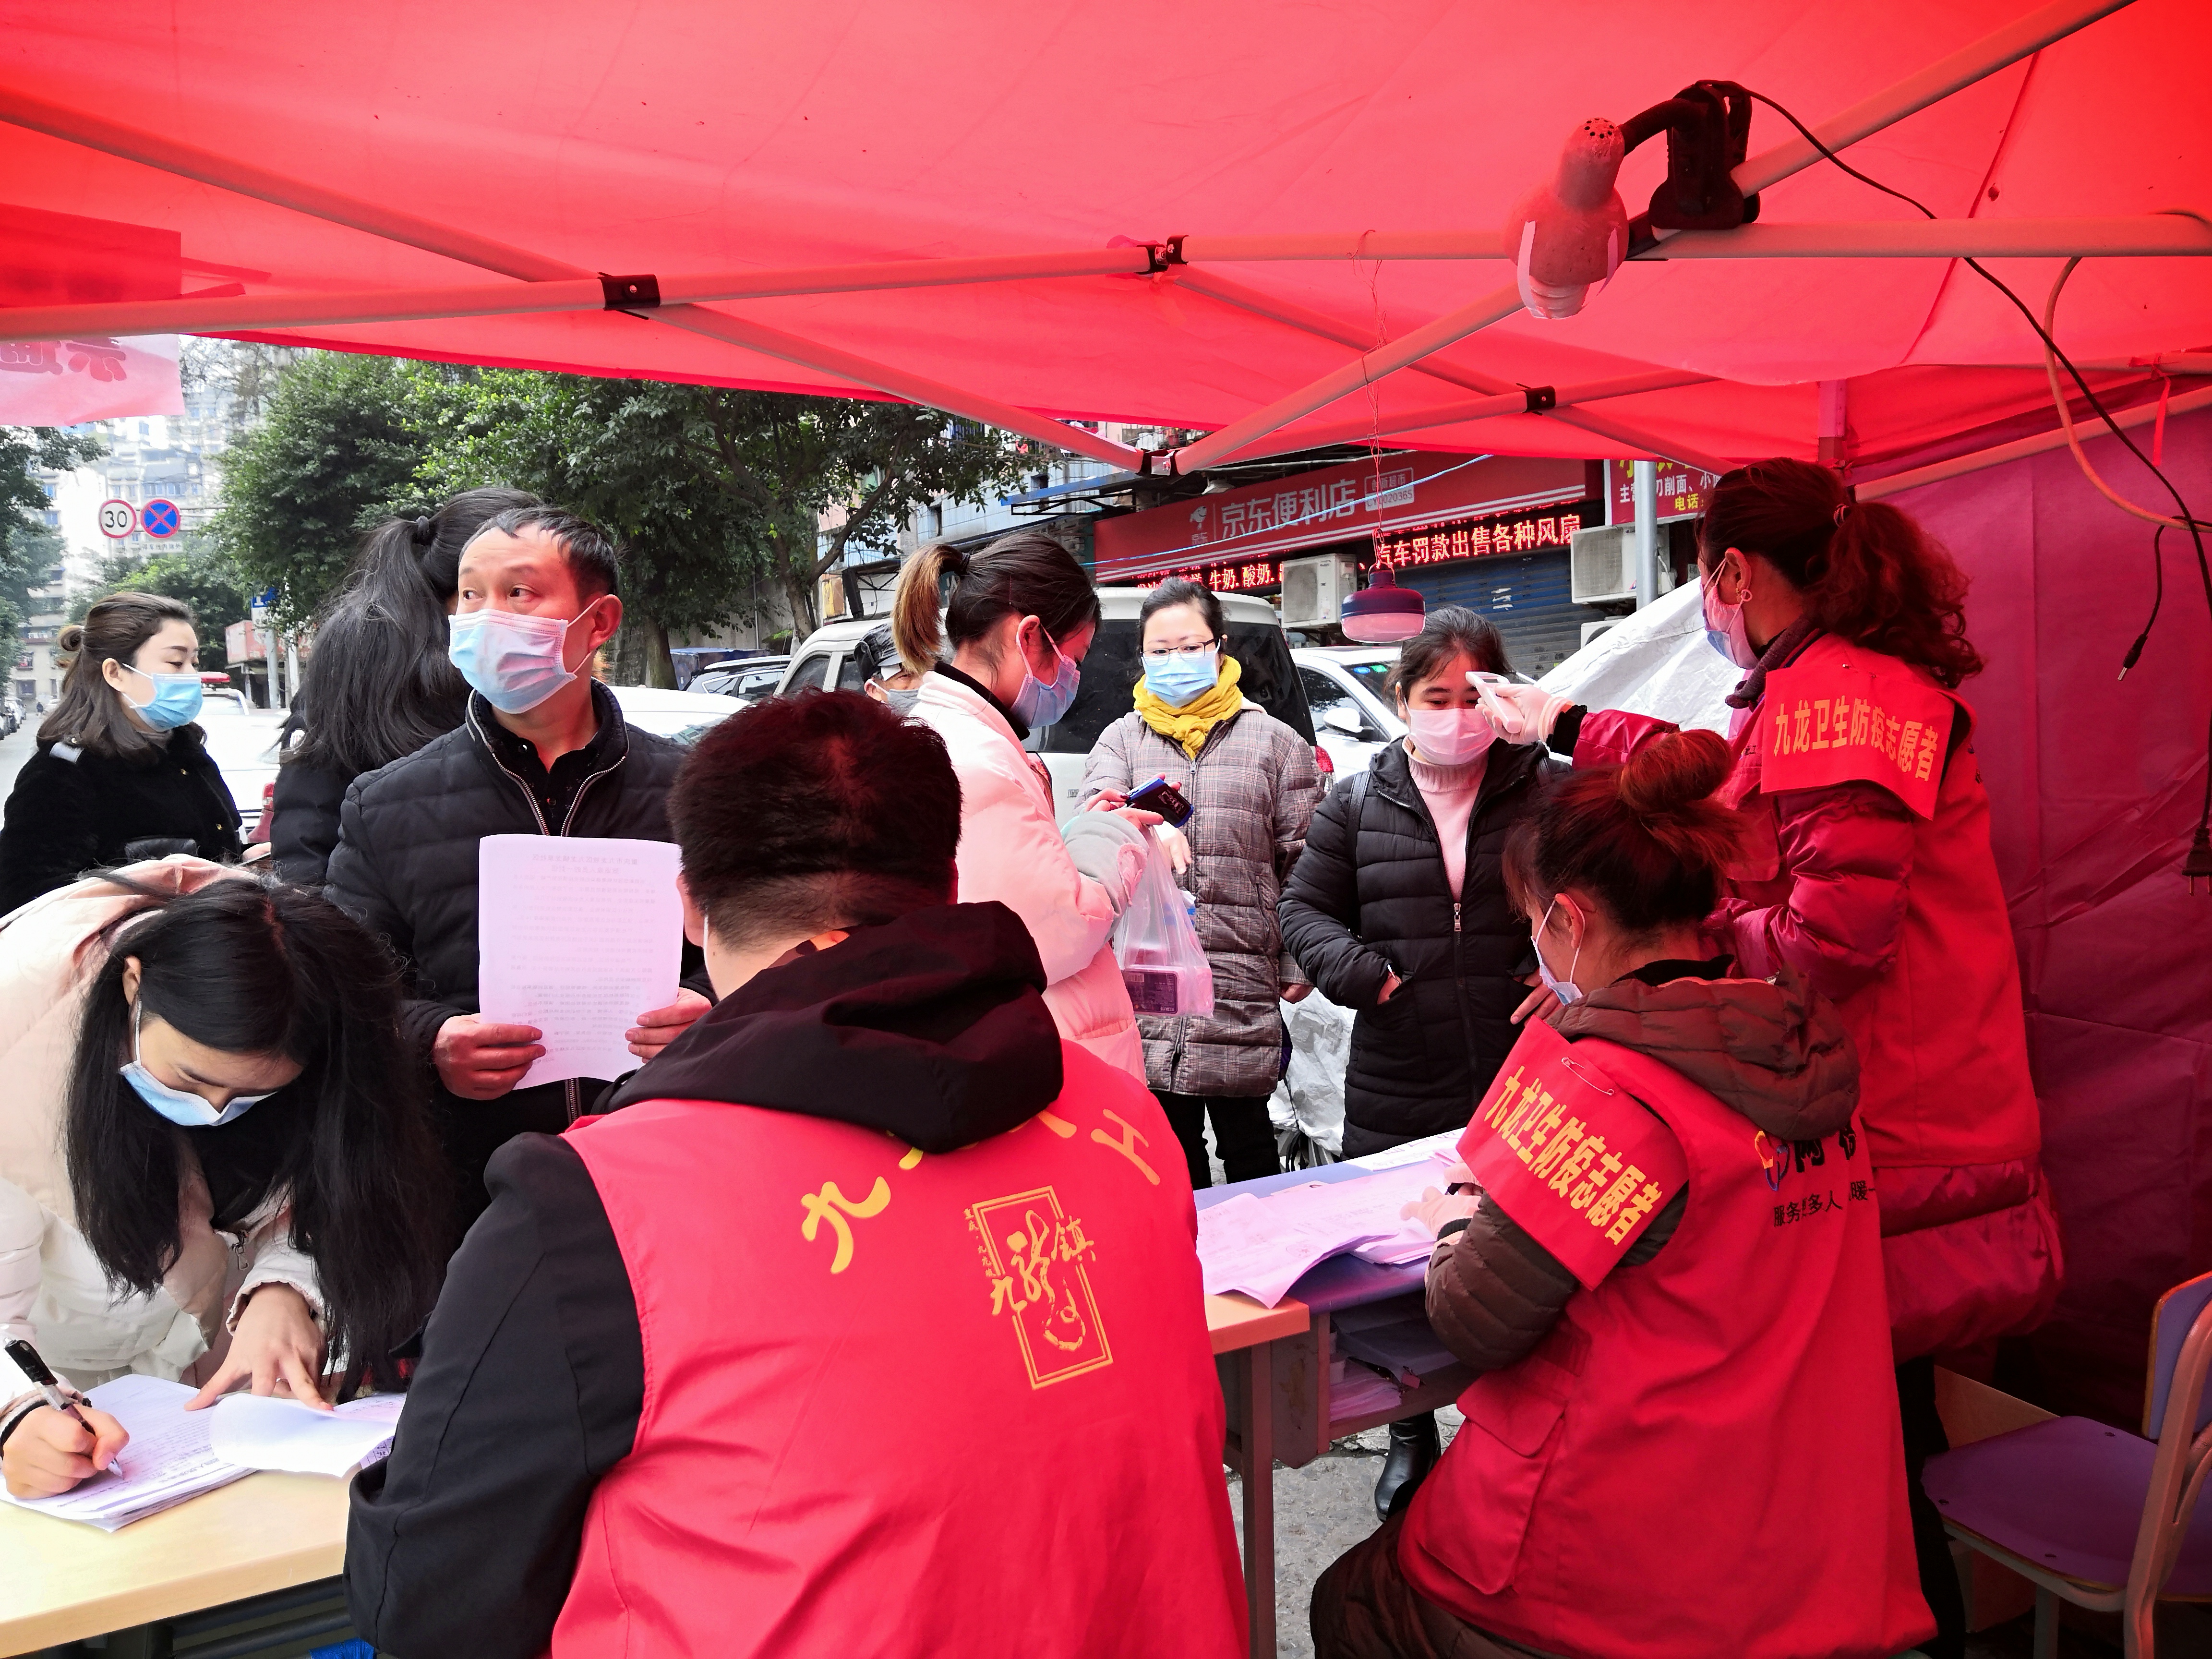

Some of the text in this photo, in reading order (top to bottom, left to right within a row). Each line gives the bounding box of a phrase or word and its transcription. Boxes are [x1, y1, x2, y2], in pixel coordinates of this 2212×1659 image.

[1619, 481, 1635, 503] 主
[104, 510, 128, 528] 30
[1221, 479, 1356, 540] 京东便利店
[1191, 531, 1208, 546] 京东
[1208, 563, 1283, 591] 牛奶.酸奶.
[1773, 695, 1940, 782] 九龙卫生防疫志愿者
[1483, 1065, 1662, 1246] 九龙卫生防疫志愿者
